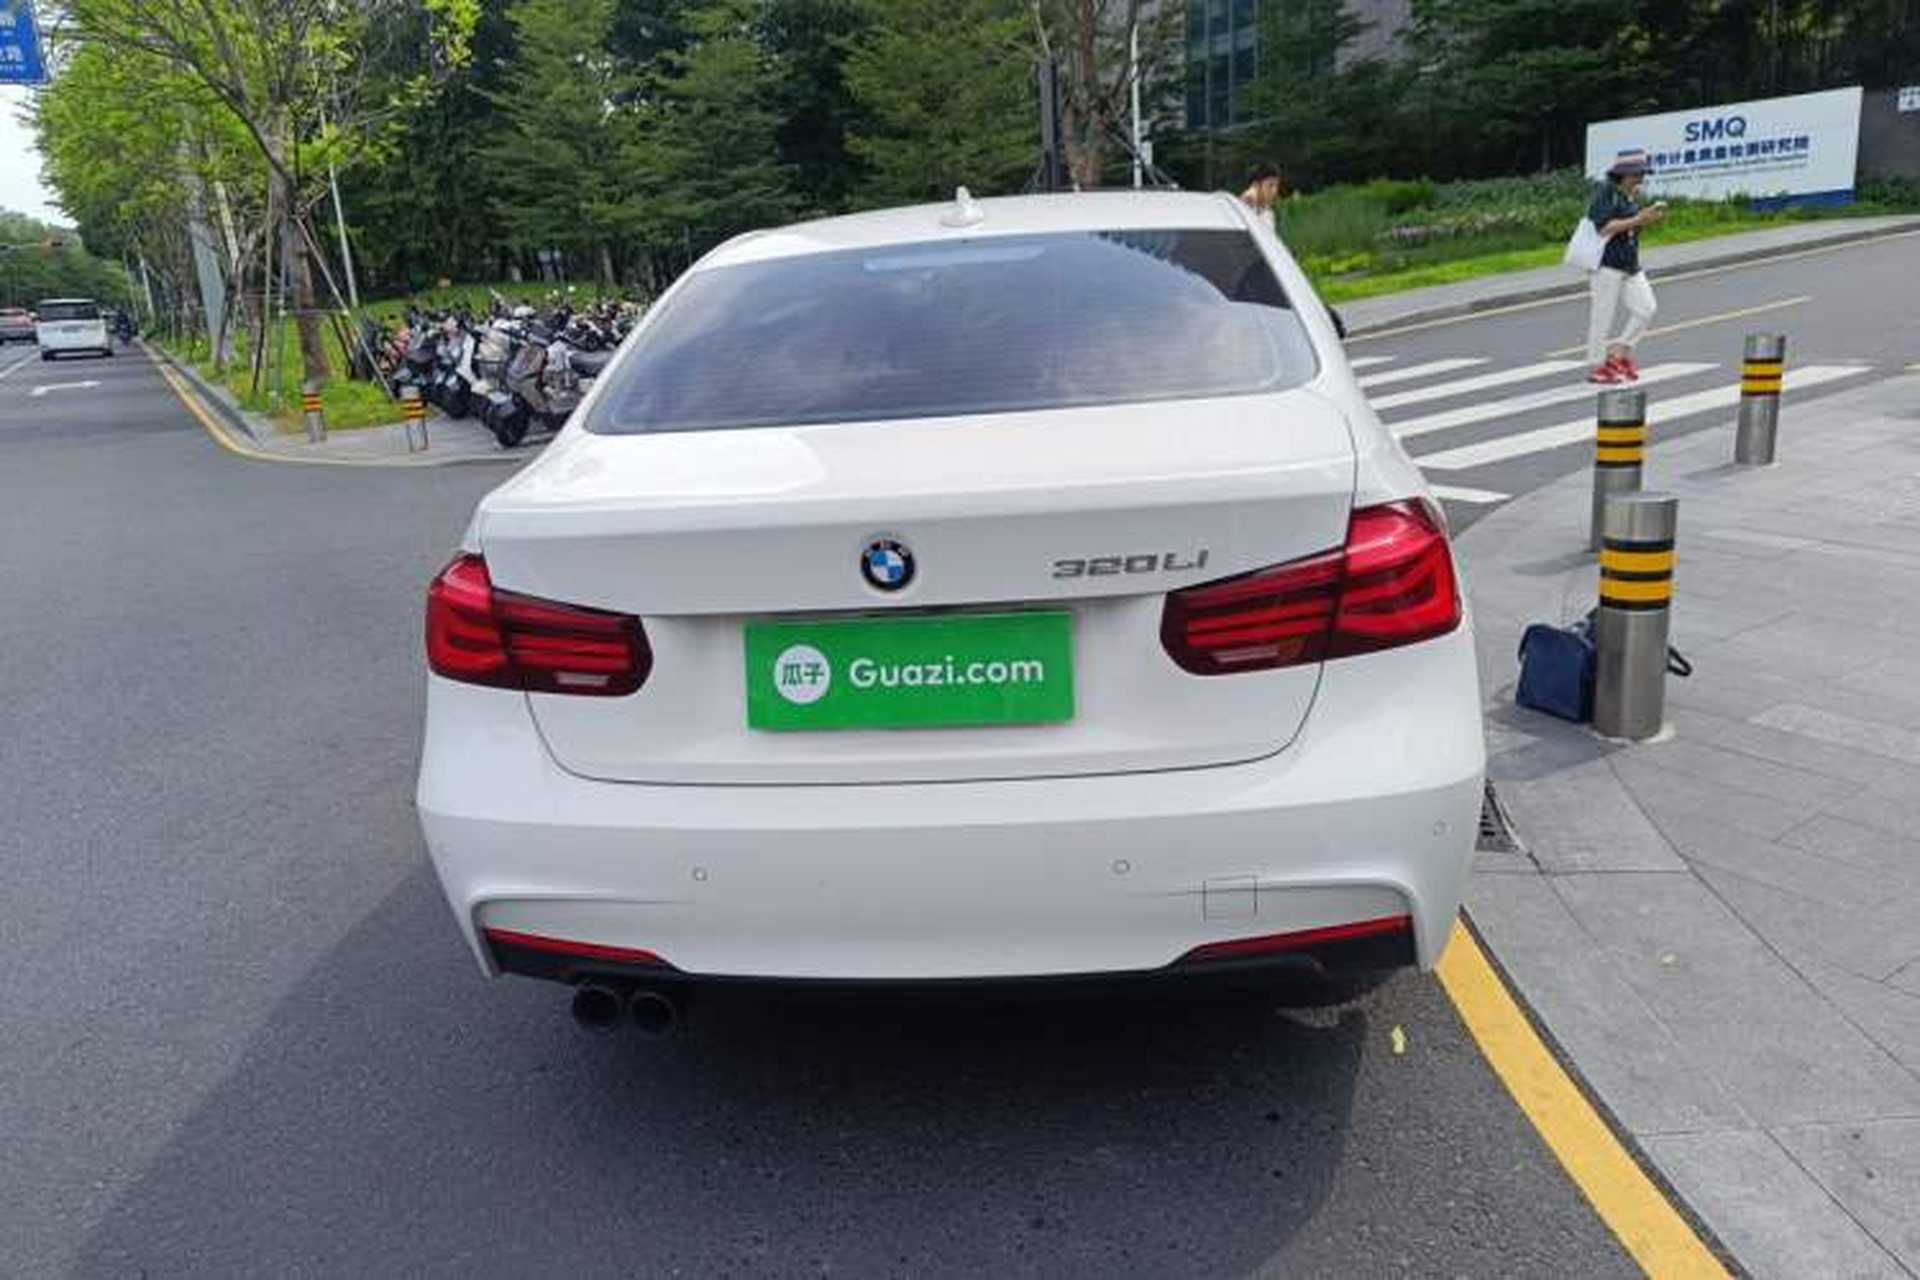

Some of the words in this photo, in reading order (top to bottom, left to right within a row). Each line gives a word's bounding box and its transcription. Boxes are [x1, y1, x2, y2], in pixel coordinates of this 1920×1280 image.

[1684, 116, 1746, 142] SMQ
[782, 662, 825, 686] 瓜子
[849, 655, 1044, 688] Guazi.com
